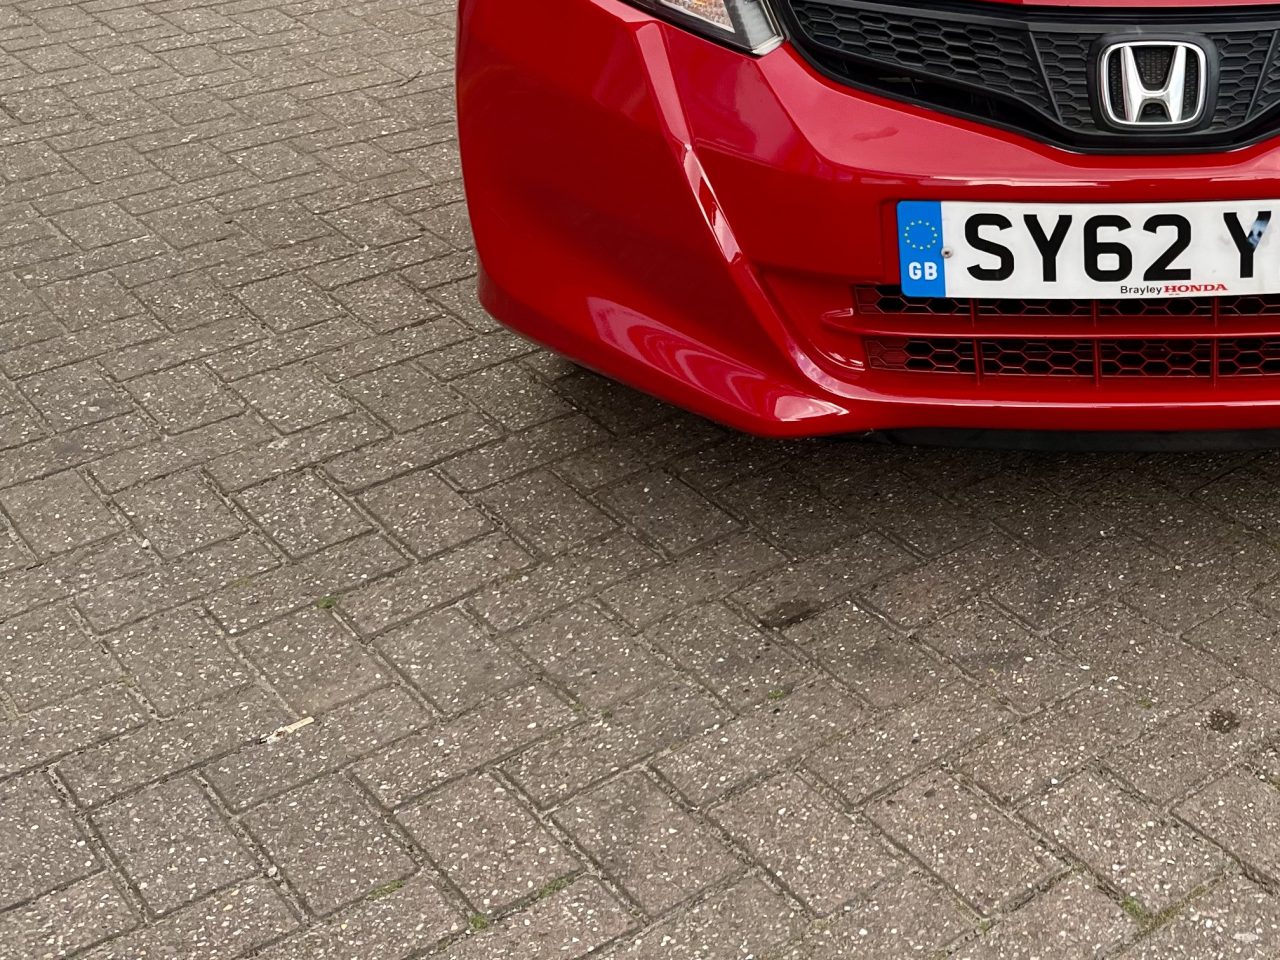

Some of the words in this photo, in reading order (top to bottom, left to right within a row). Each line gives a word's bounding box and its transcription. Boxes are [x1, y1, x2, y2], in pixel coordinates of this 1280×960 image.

[964, 212, 1192, 283] SY62
[909, 262, 938, 280] GB
[1120, 285, 1162, 295] Brayley
[1164, 284, 1228, 293] HONDA
